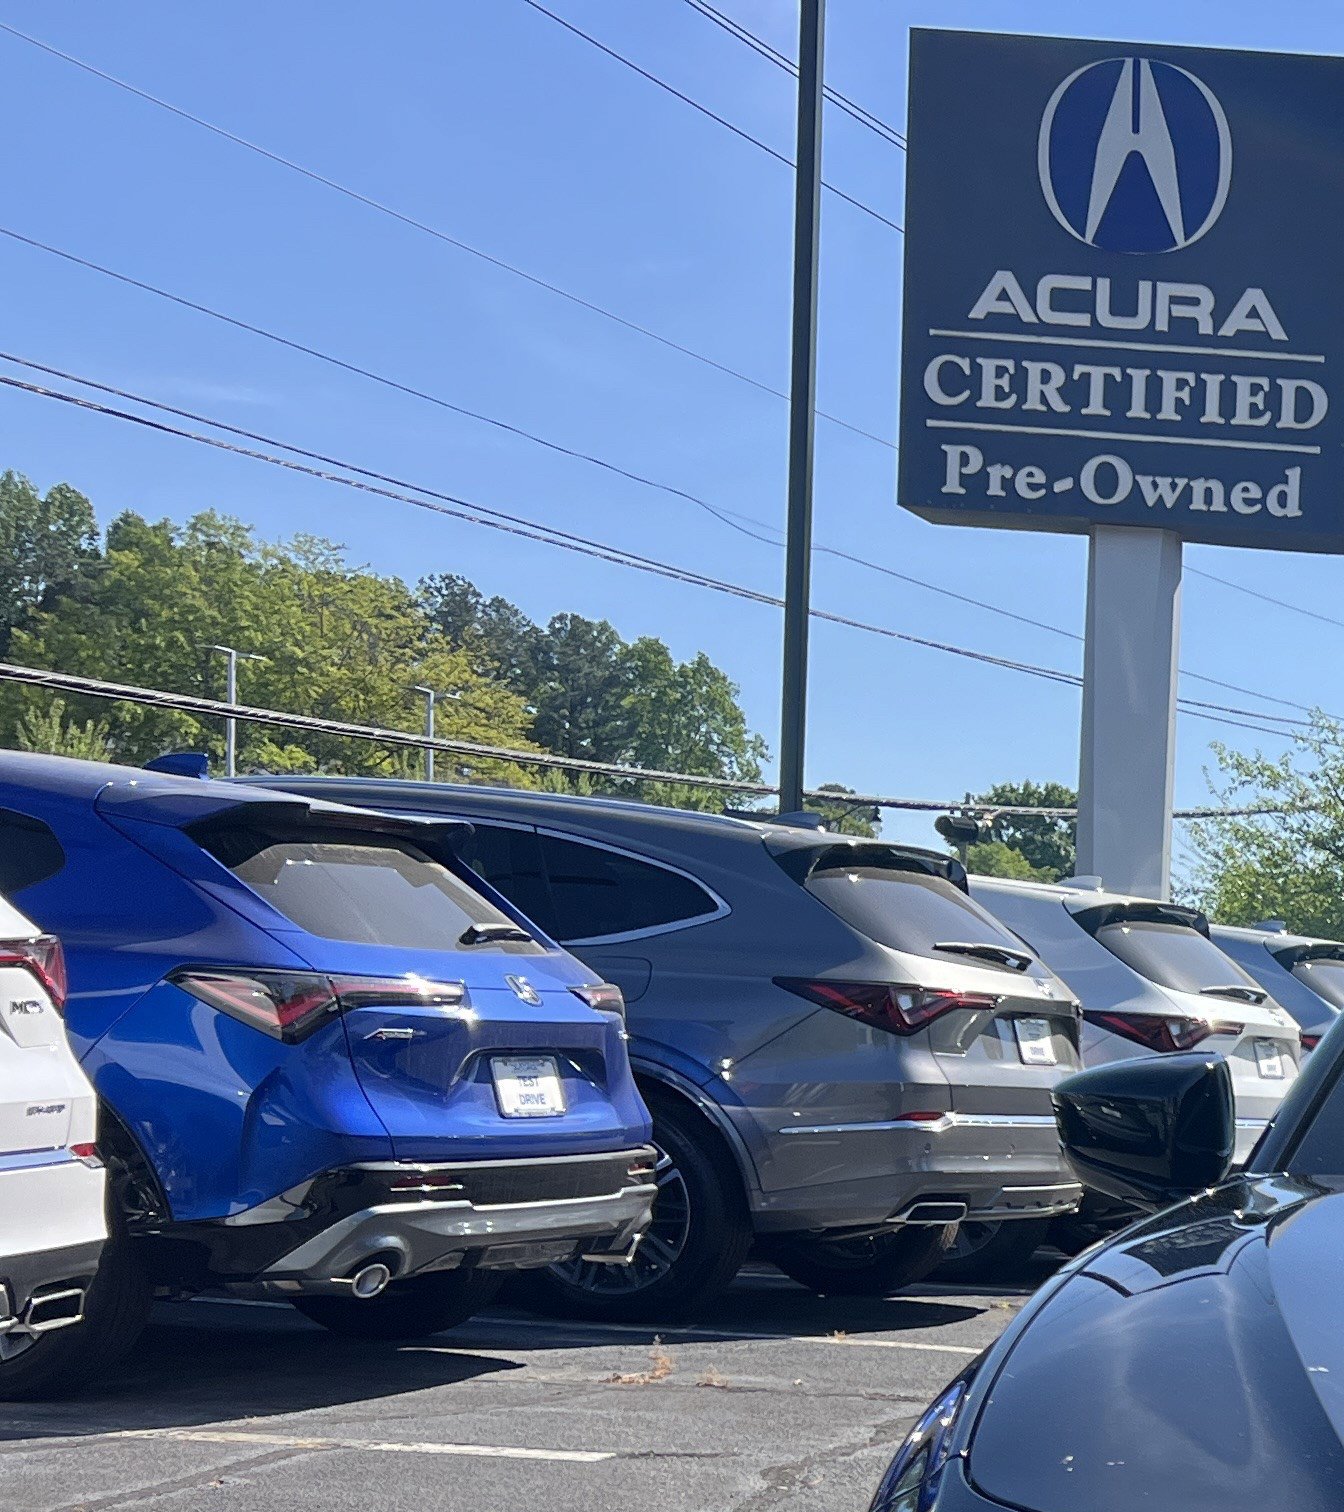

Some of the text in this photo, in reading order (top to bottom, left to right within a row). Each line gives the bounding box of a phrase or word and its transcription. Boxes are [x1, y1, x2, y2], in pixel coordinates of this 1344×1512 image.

[967, 270, 1290, 341] ACURA
[923, 353, 1329, 431] CERTIFIED
[940, 443, 1303, 518] Pre-Owned
[515, 1075, 540, 1087] TEST
[518, 1093, 547, 1106] DRIVE
